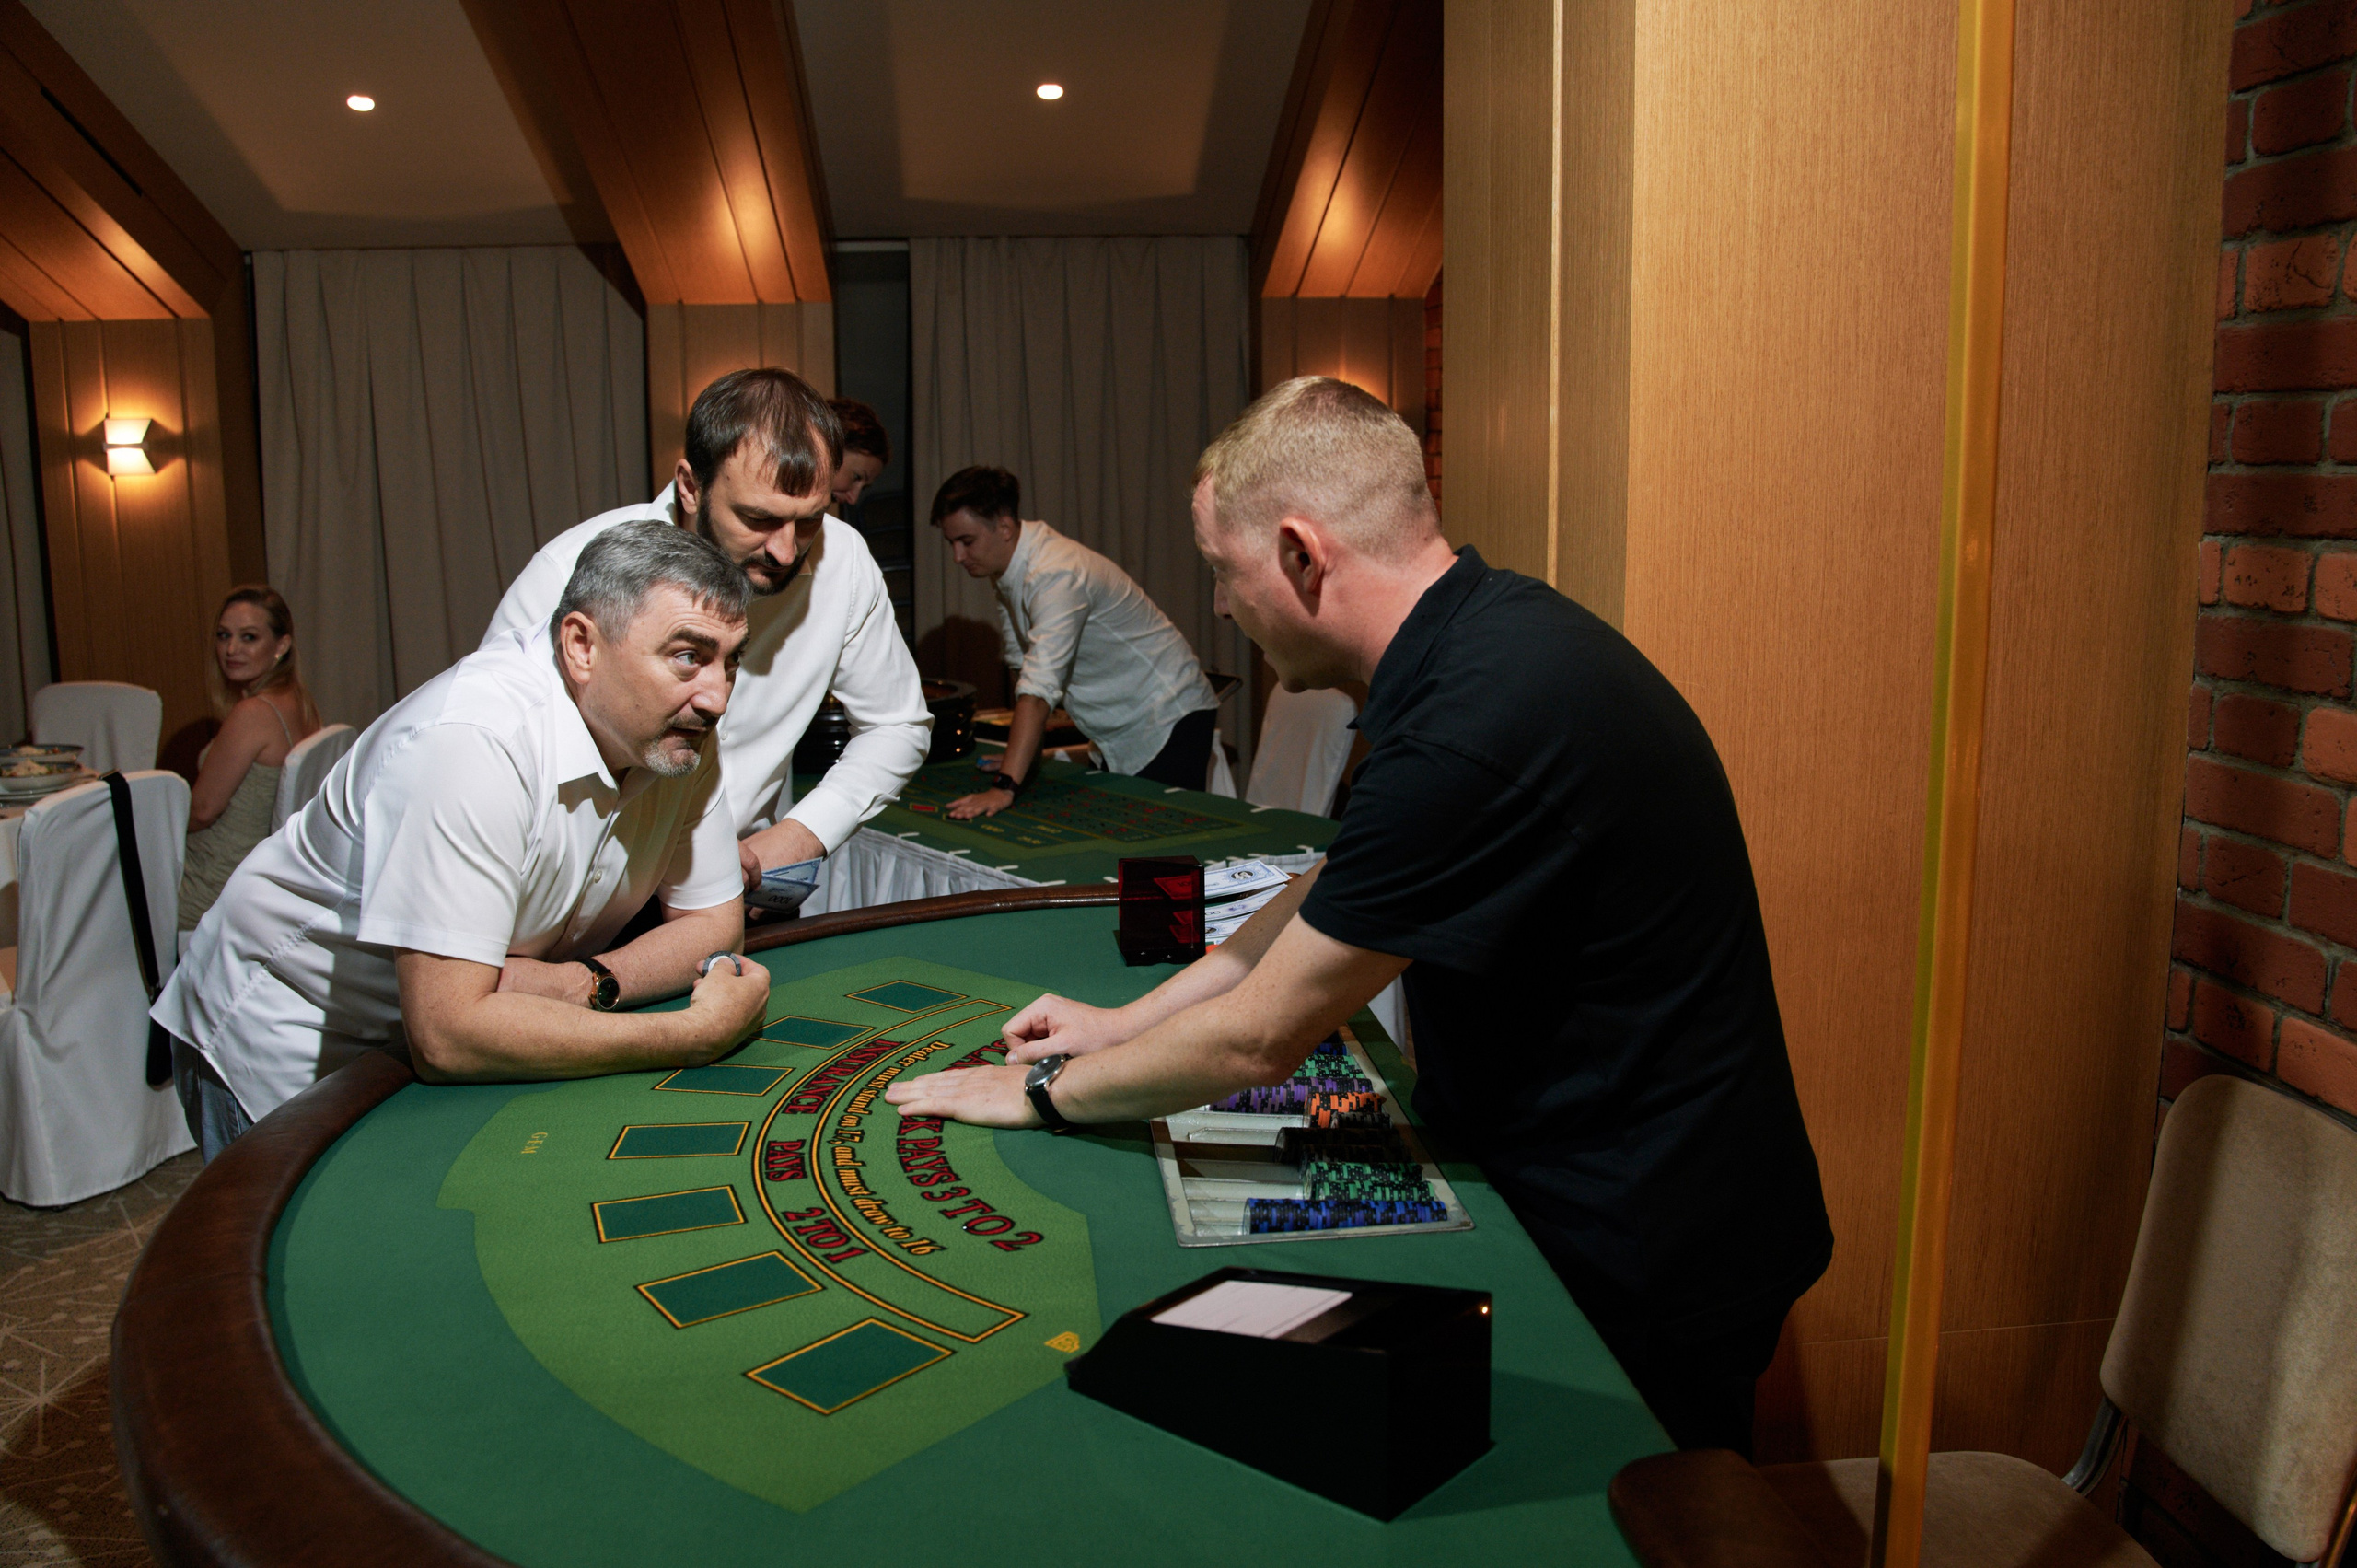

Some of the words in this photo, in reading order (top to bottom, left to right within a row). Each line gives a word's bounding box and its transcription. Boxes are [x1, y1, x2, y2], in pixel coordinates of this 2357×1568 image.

[895, 1040, 955, 1067] Dealer
[782, 1039, 906, 1114] INSURANCE
[865, 1066, 905, 1089] must
[844, 1087, 880, 1115] stand
[838, 1114, 863, 1128] on
[826, 1129, 865, 1144] 17,
[765, 1139, 807, 1181] PAYS
[831, 1145, 866, 1167] and
[896, 1135, 962, 1187] PAYS
[834, 1168, 877, 1196] must
[921, 1186, 971, 1202] 3
[782, 1207, 826, 1222] 2
[850, 1197, 899, 1225] draw
[938, 1198, 1016, 1236] TO
[793, 1217, 851, 1249] TO
[879, 1225, 913, 1240] to
[988, 1231, 1045, 1252] 2
[821, 1247, 870, 1264] 1
[895, 1237, 948, 1256] 16
